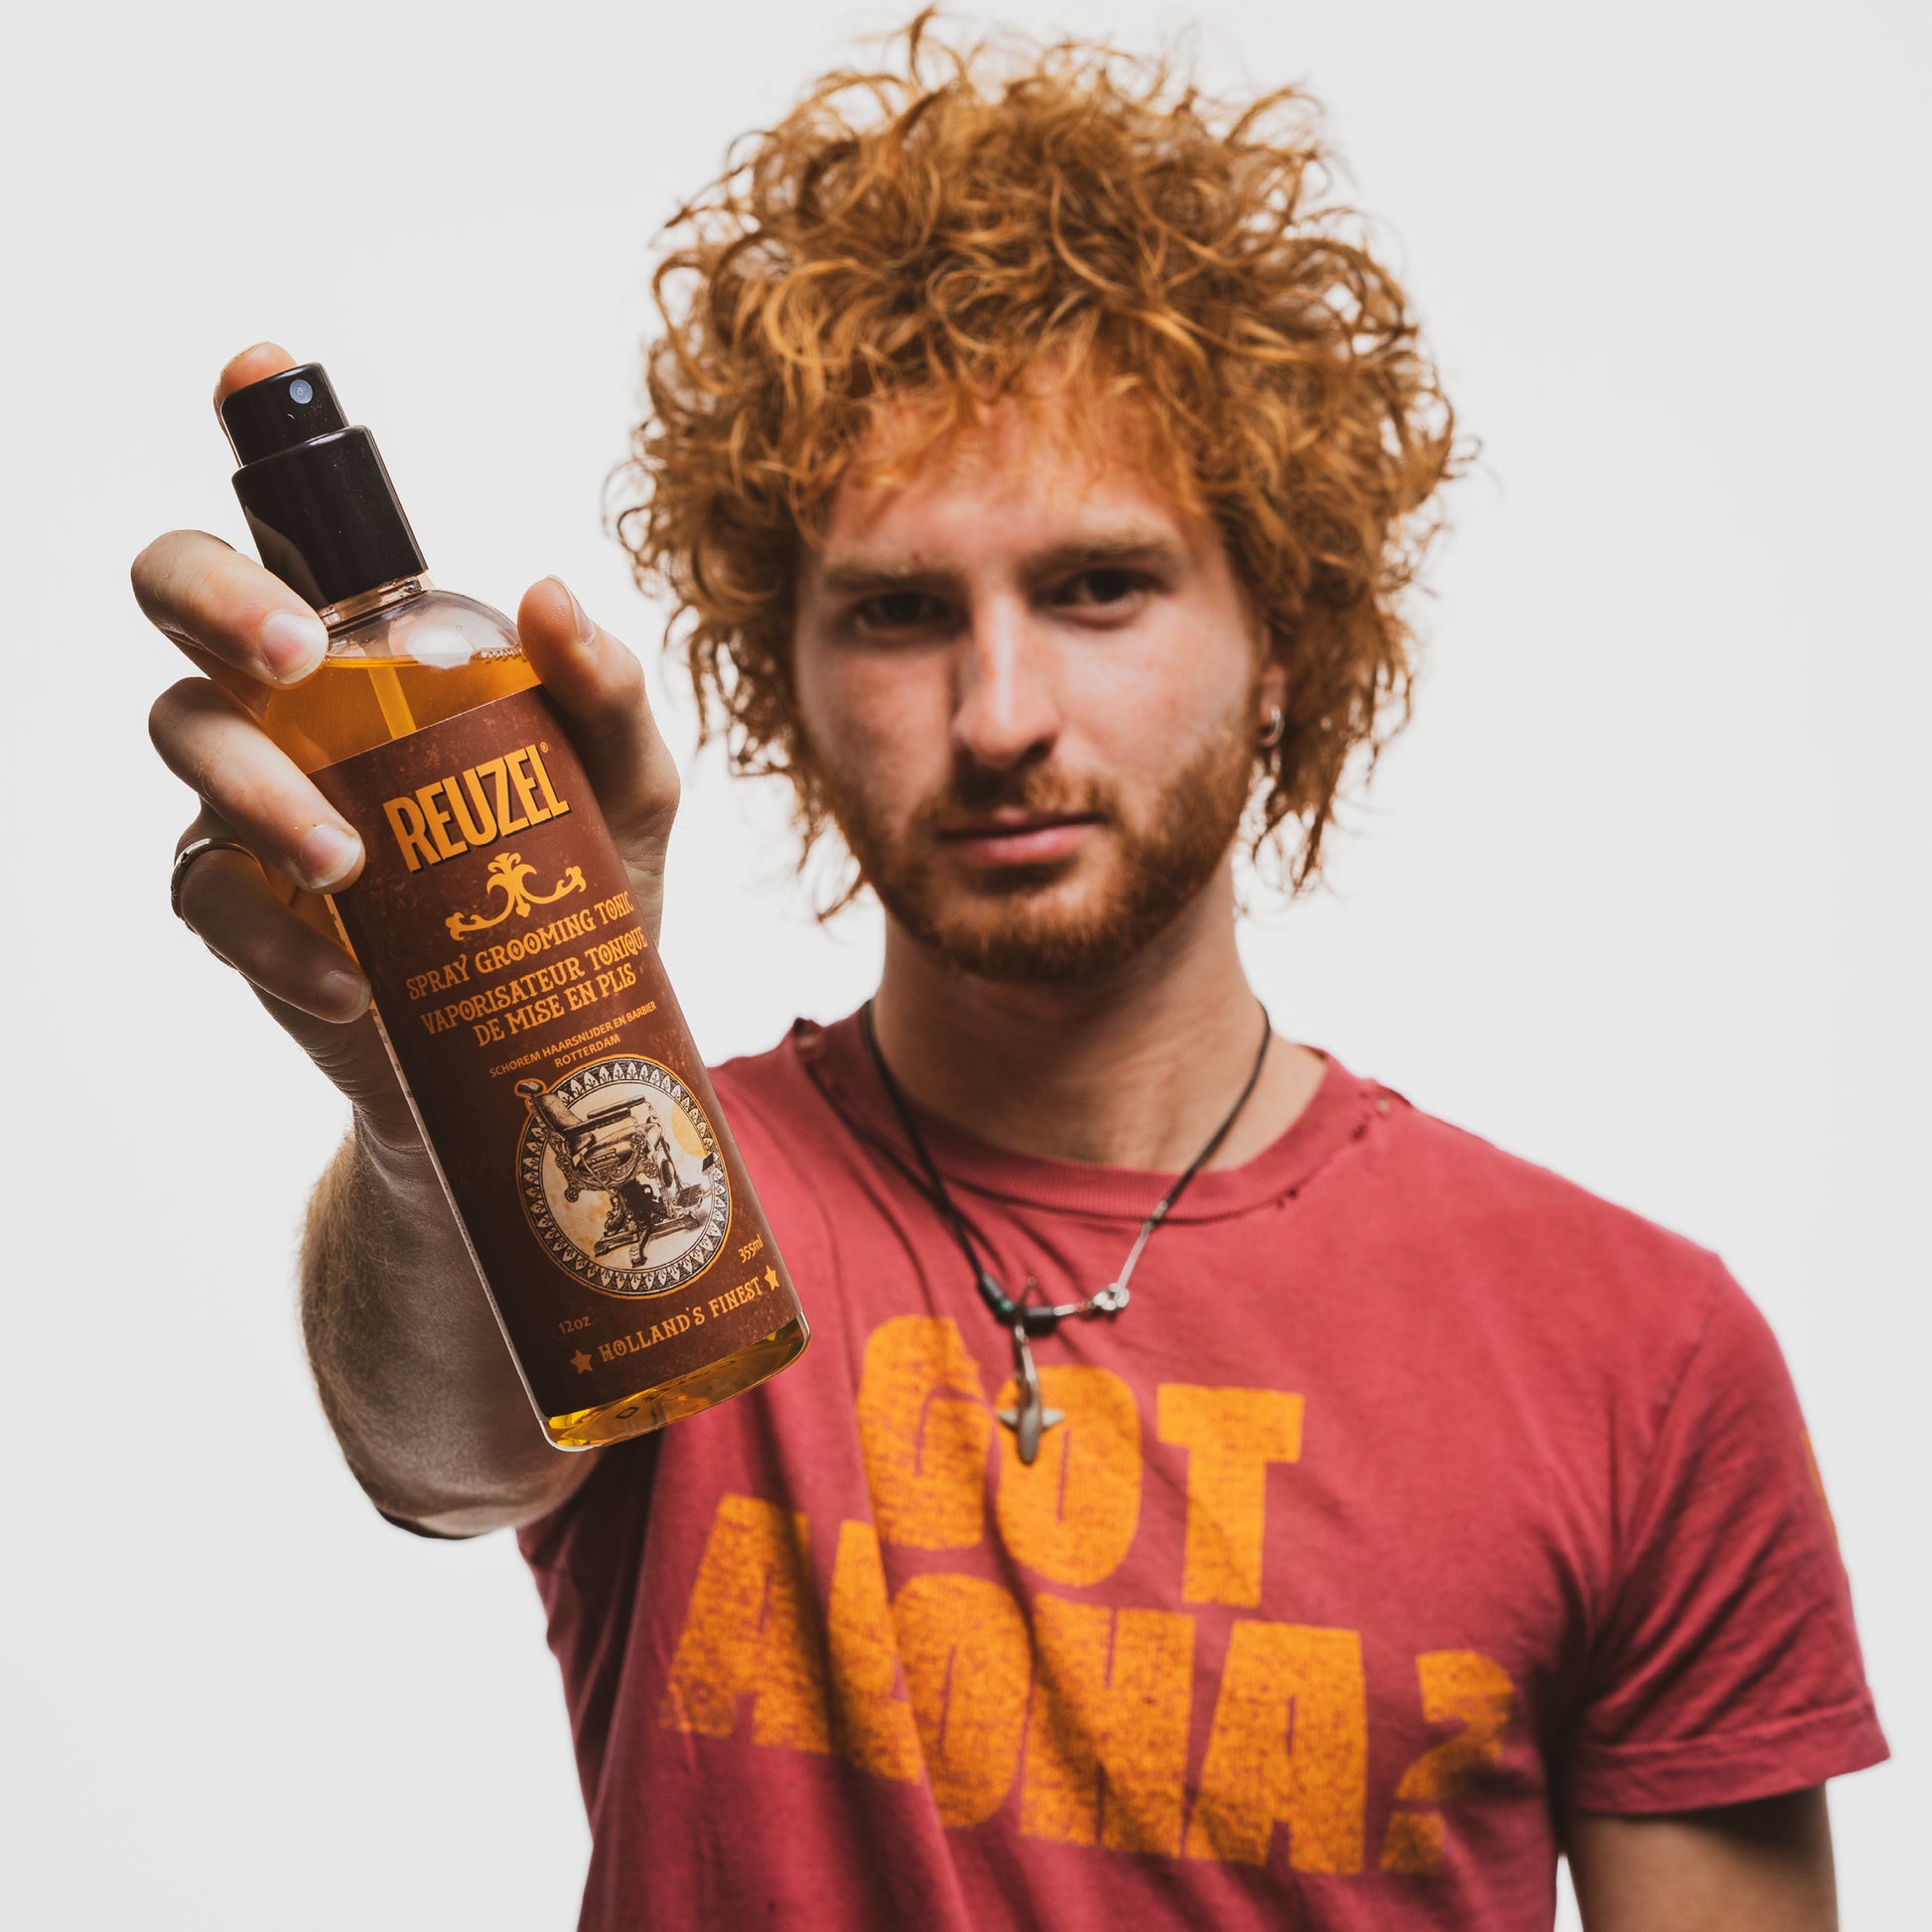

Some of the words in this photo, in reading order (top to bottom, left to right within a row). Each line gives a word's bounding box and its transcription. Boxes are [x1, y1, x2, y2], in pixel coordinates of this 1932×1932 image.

[406, 953, 470, 1001] SPRAY
[475, 908, 597, 974] GROOMING
[594, 891, 634, 925] TONIC
[420, 957, 585, 1035] VAPORISATEUR
[584, 925, 649, 971] TONIQUE
[472, 1024, 505, 1046] DE
[504, 994, 565, 1035] MISE
[564, 980, 597, 1011] EN
[595, 962, 636, 998] PLIS
[488, 1052, 541, 1078] SCHOREM
[613, 1015, 627, 1029] EN
[626, 1001, 657, 1023] BARBIER
[554, 1033, 621, 1068] ROTTERDAM
[738, 1233, 763, 1264] 355ml
[597, 1306, 706, 1363] HOLLAND'S
[708, 1277, 763, 1318] FINEST
[858, 1313, 1304, 1607] GOT
